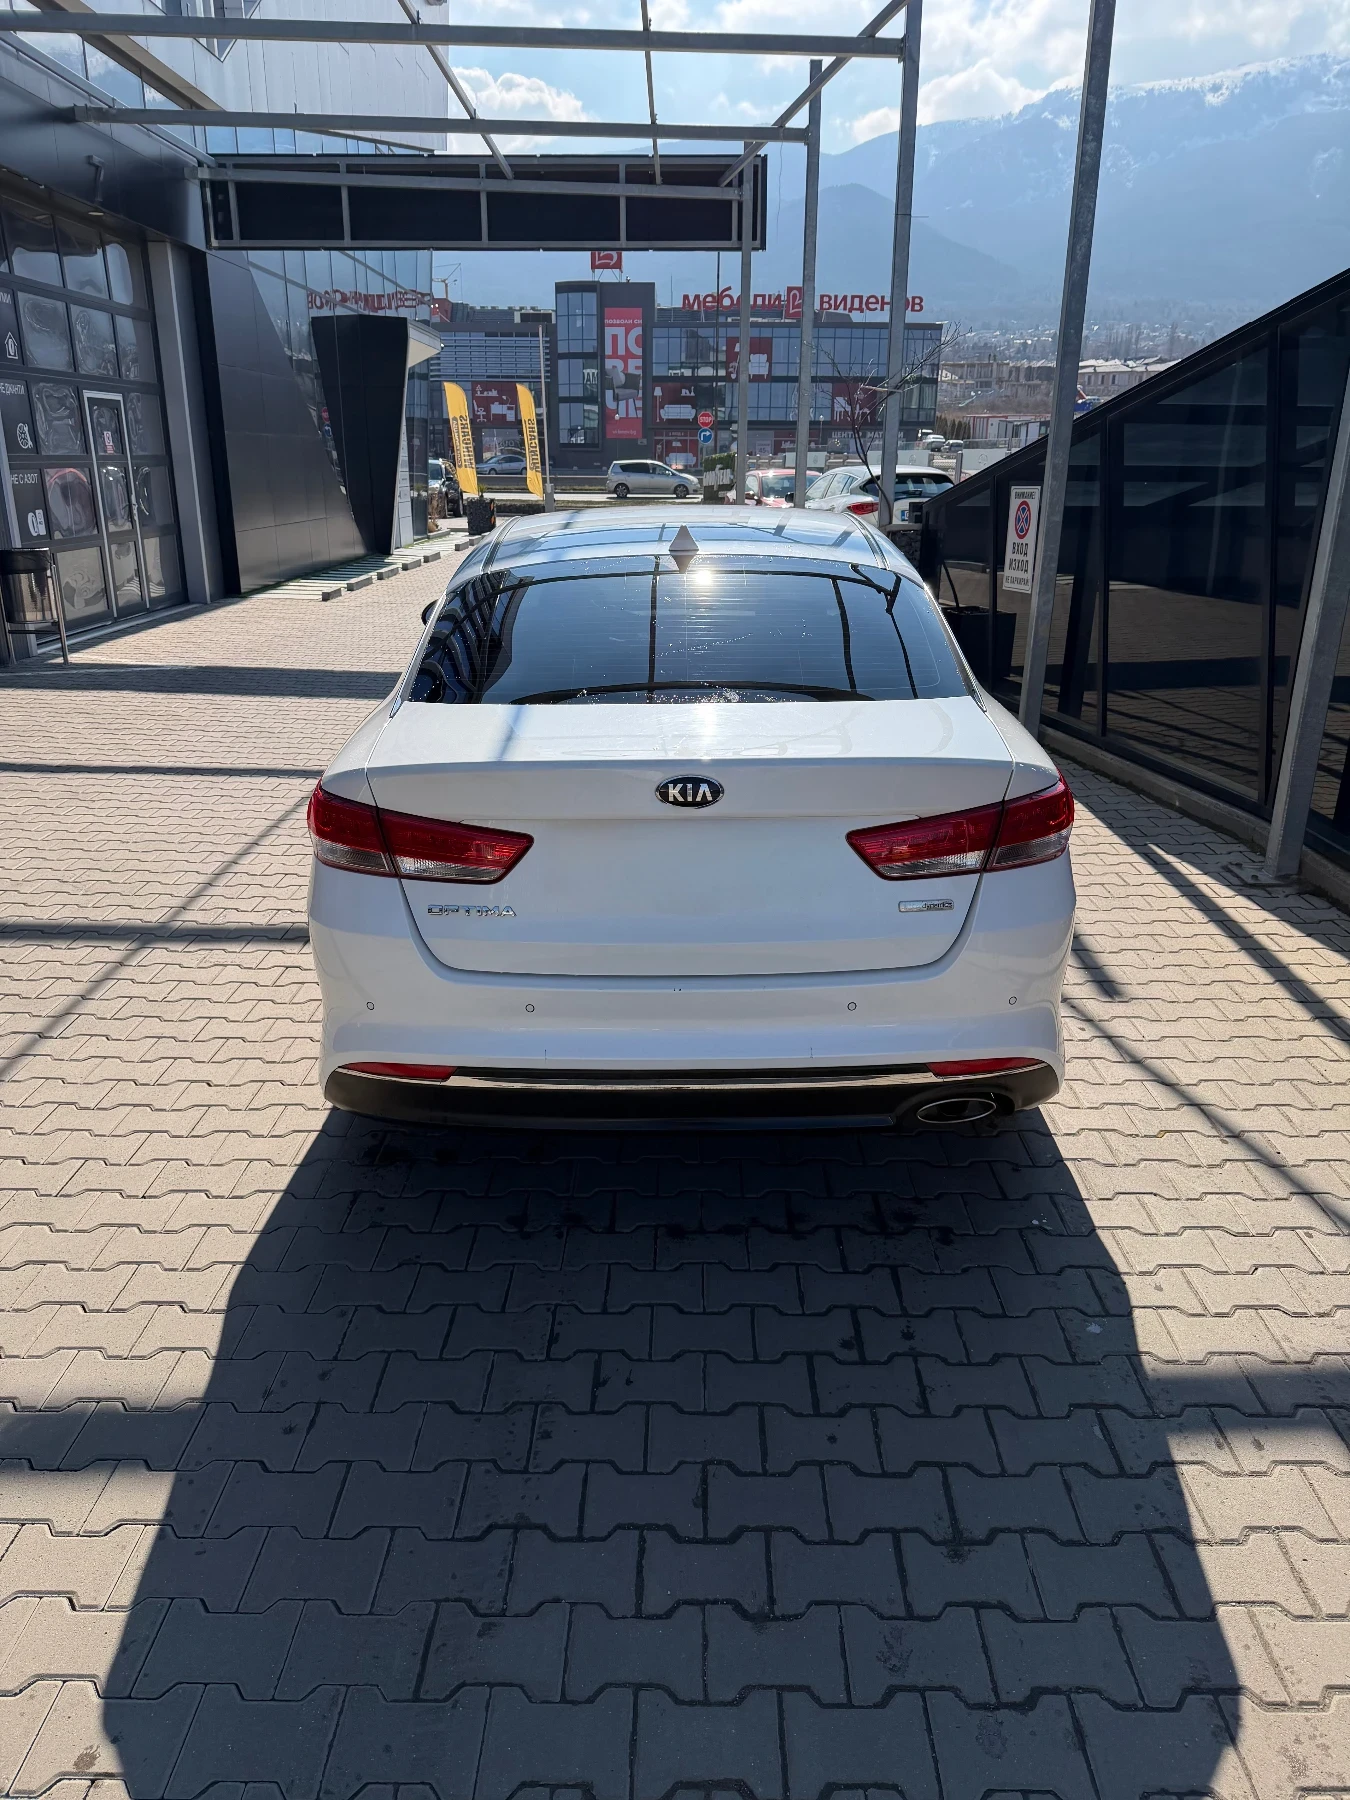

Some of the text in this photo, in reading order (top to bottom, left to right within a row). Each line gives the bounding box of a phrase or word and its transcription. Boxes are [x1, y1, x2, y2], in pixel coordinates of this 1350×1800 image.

[819, 293, 923, 313] виденв
[24, 473, 38, 484] АЗОТ
[1011, 541, 1029, 557] ВХОД
[1008, 558, 1029, 574] ИЗХОД
[1005, 575, 1011, 584] НЕ
[668, 783, 713, 802] KIA
[427, 904, 517, 917] OPTIMA
